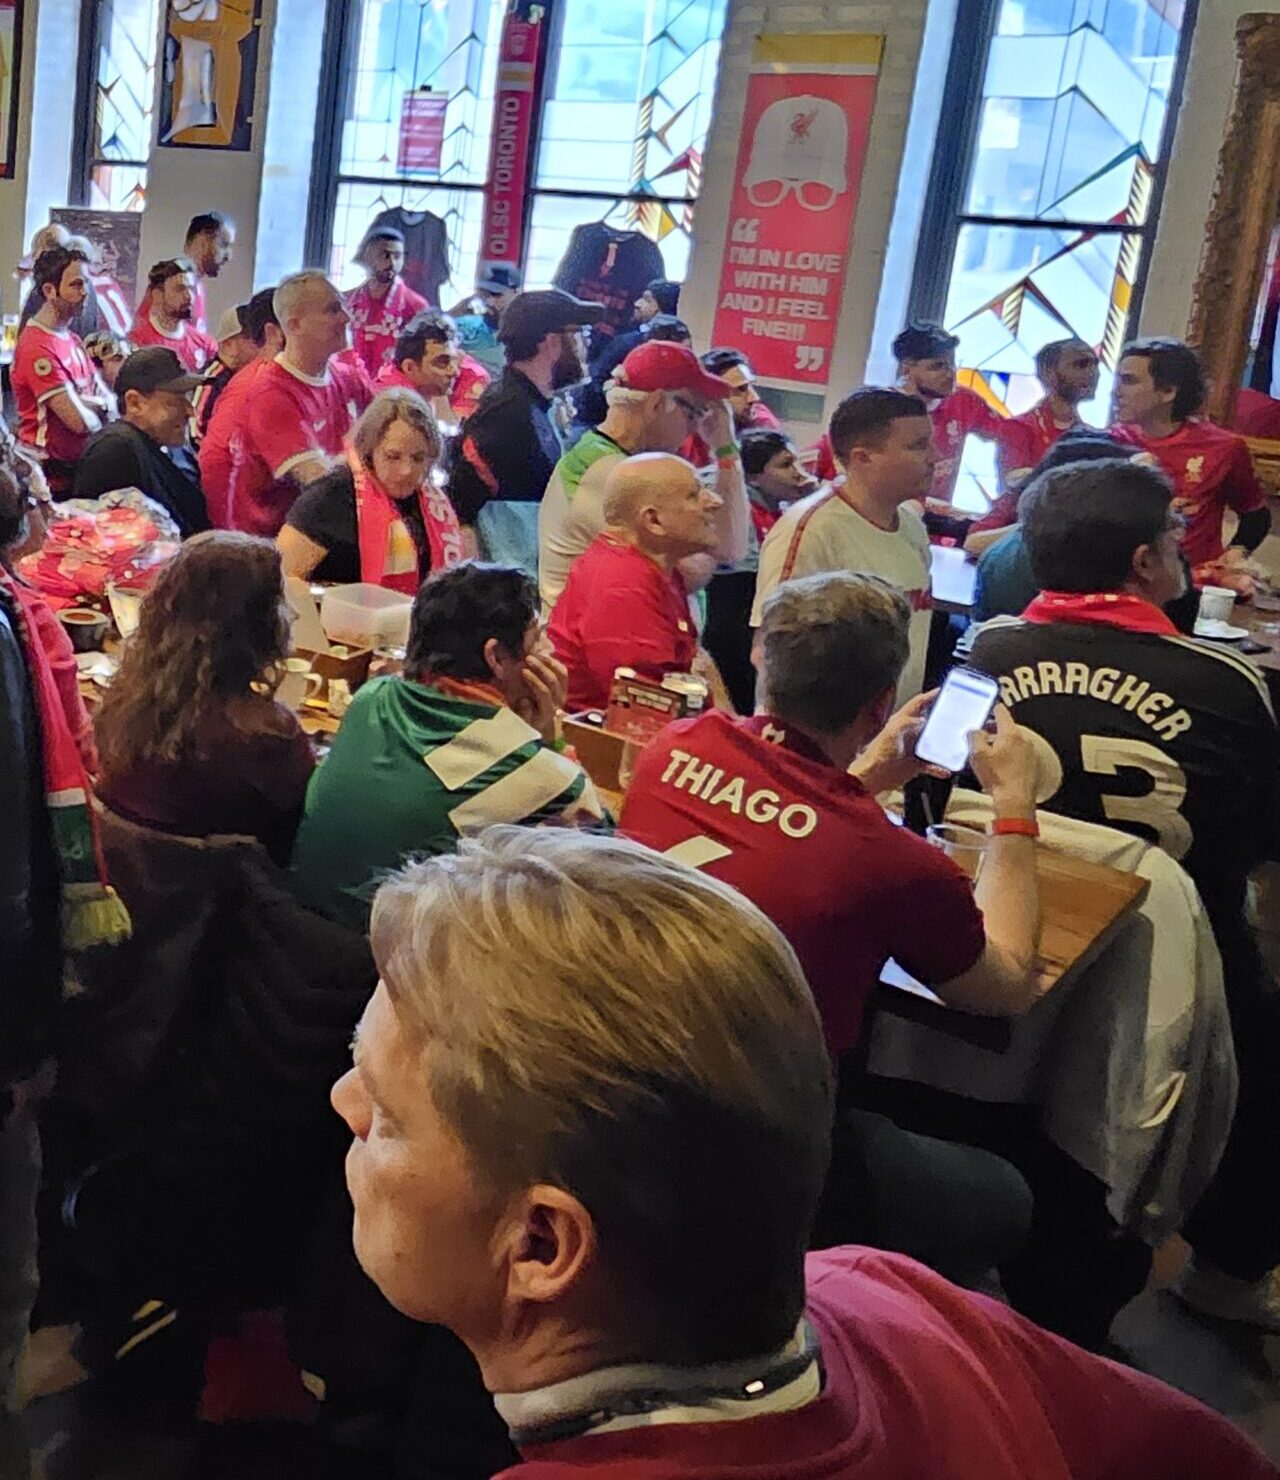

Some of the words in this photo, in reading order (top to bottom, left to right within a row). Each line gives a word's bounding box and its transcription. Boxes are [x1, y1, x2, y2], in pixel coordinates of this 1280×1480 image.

[493, 96, 521, 195] TORONTO
[489, 199, 511, 257] OLSC
[734, 270, 786, 292] WITH
[789, 275, 829, 297] HIM
[758, 248, 781, 268] IN
[783, 250, 843, 273] LOVE
[720, 292, 764, 313] AND
[766, 296, 775, 315] I
[776, 298, 830, 320] FEEL
[998, 661, 1193, 742] ARRAGHER
[660, 748, 818, 839] THIAGO
